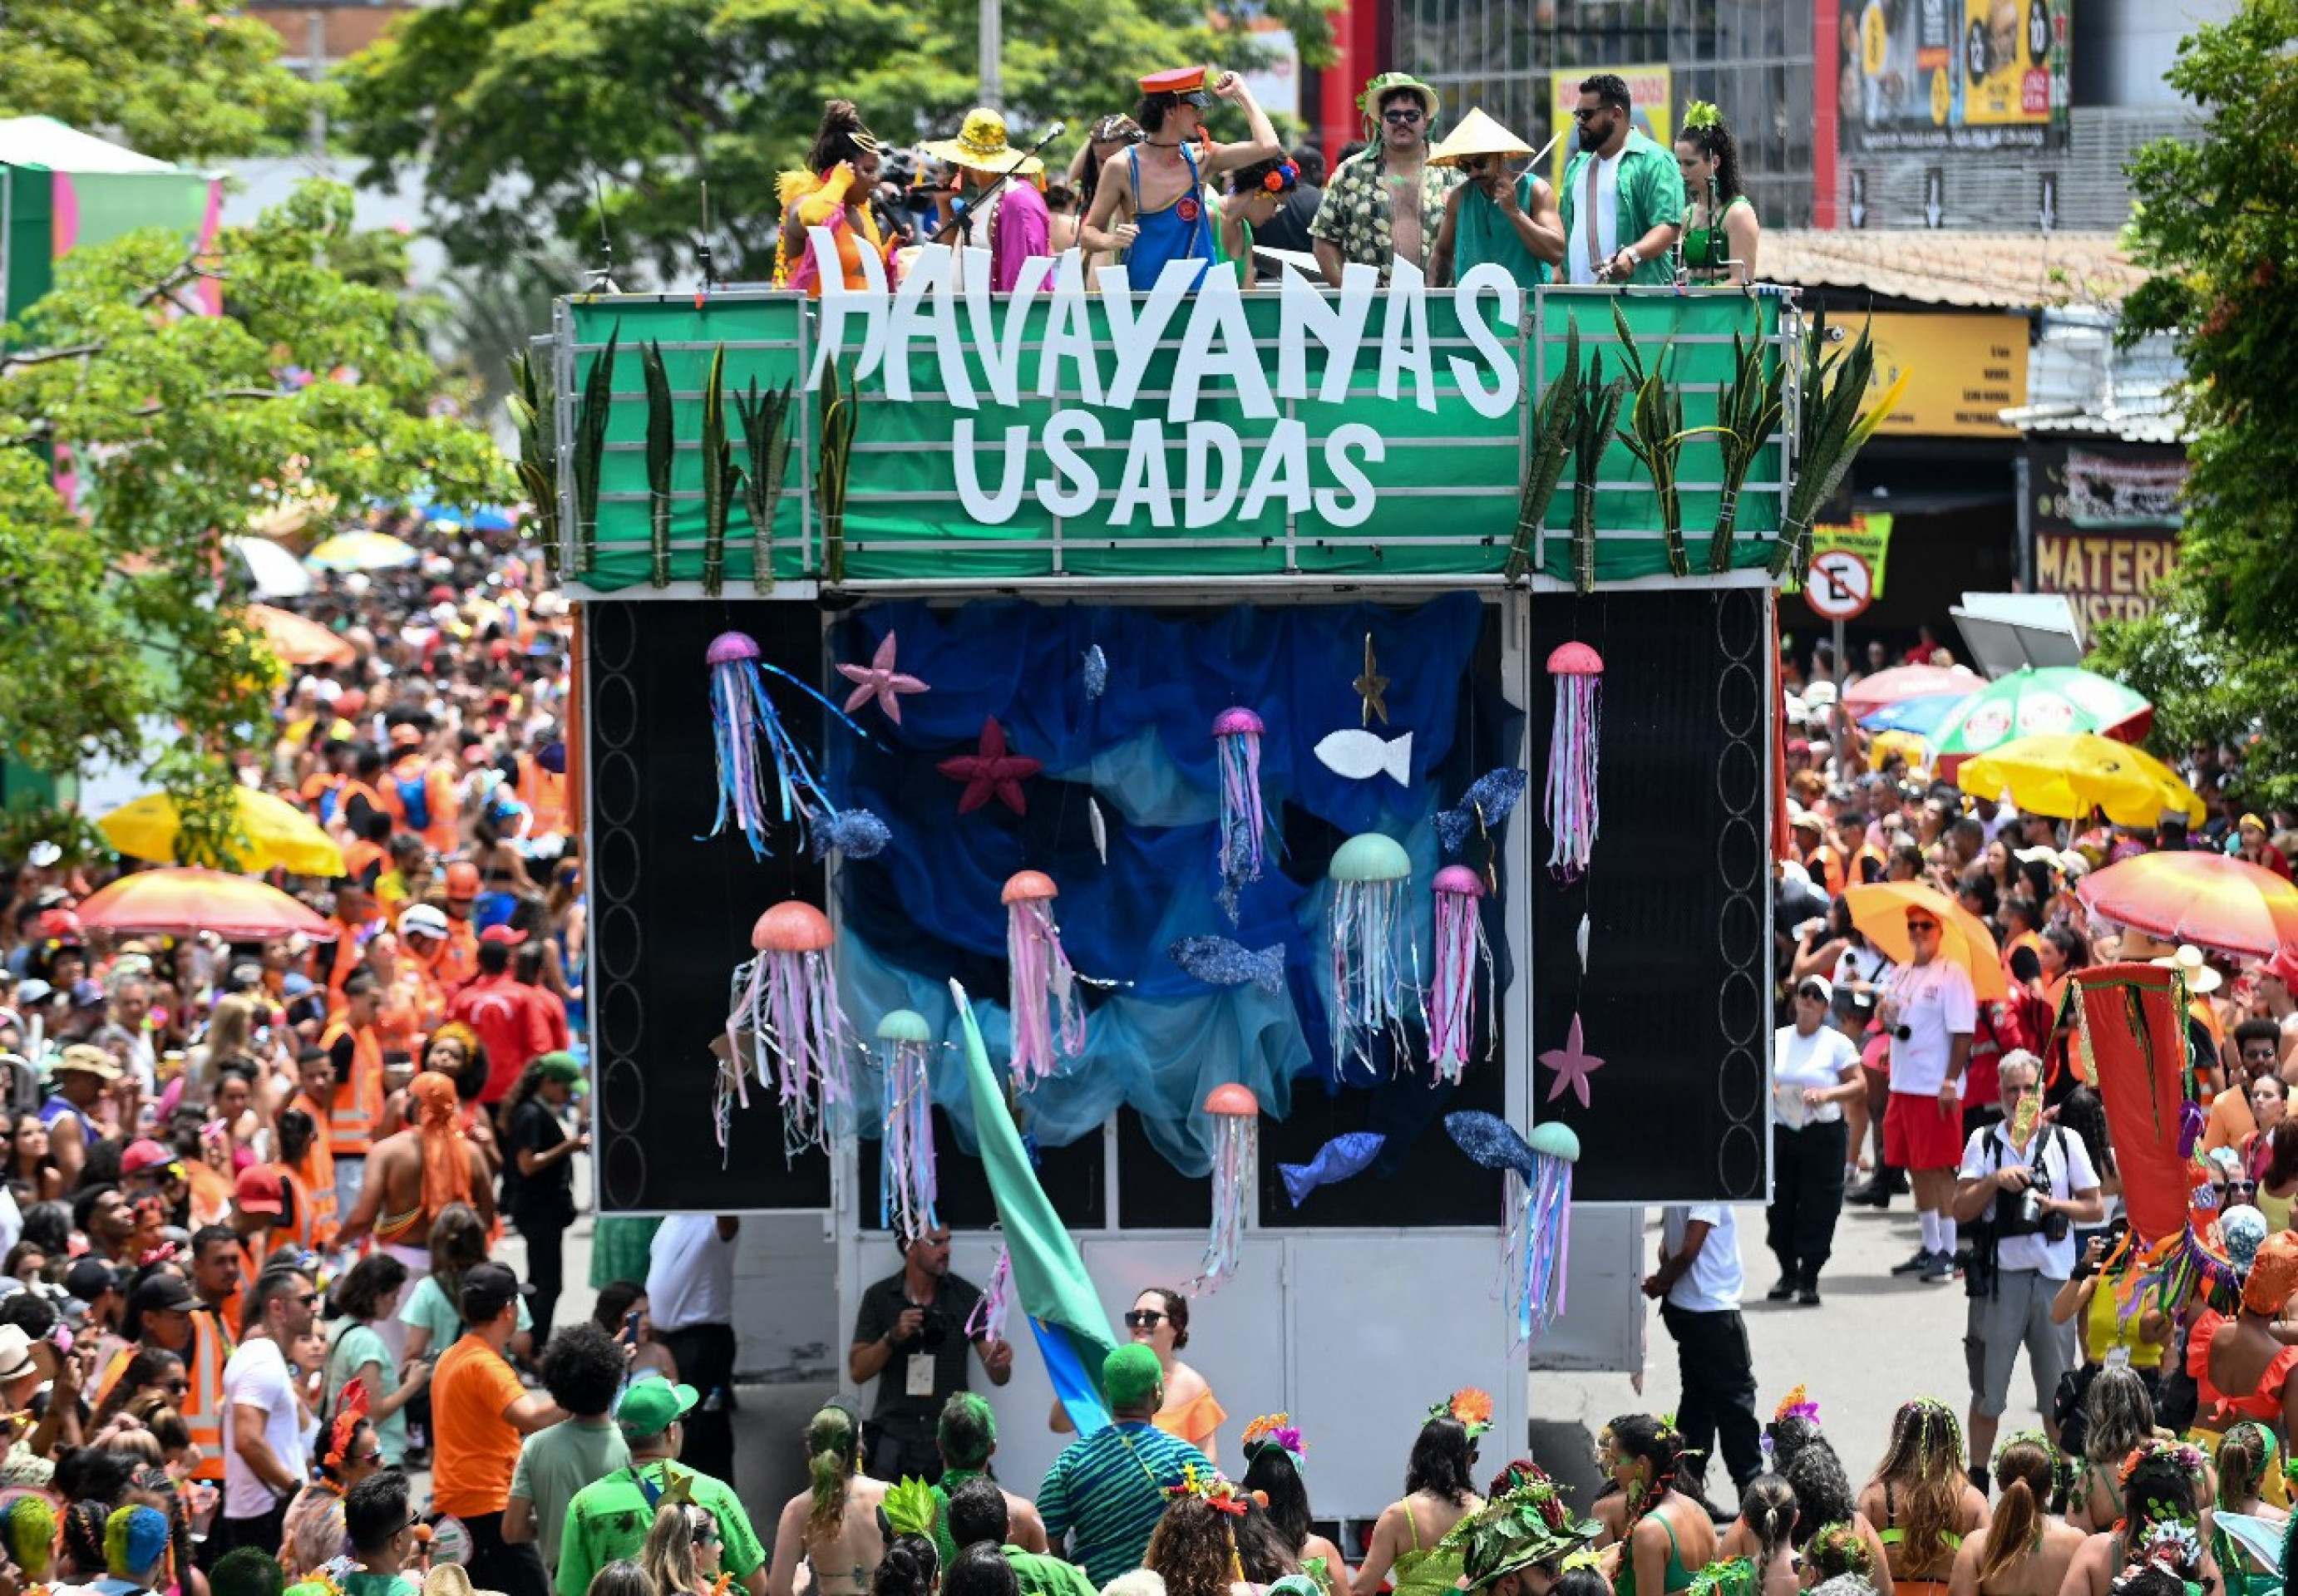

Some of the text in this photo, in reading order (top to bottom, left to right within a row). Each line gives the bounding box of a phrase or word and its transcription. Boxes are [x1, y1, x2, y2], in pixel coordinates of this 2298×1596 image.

[806, 225, 1520, 424] HAVAYANAS
[953, 408, 1385, 529] USADAS
[1828, 566, 1850, 599] E
